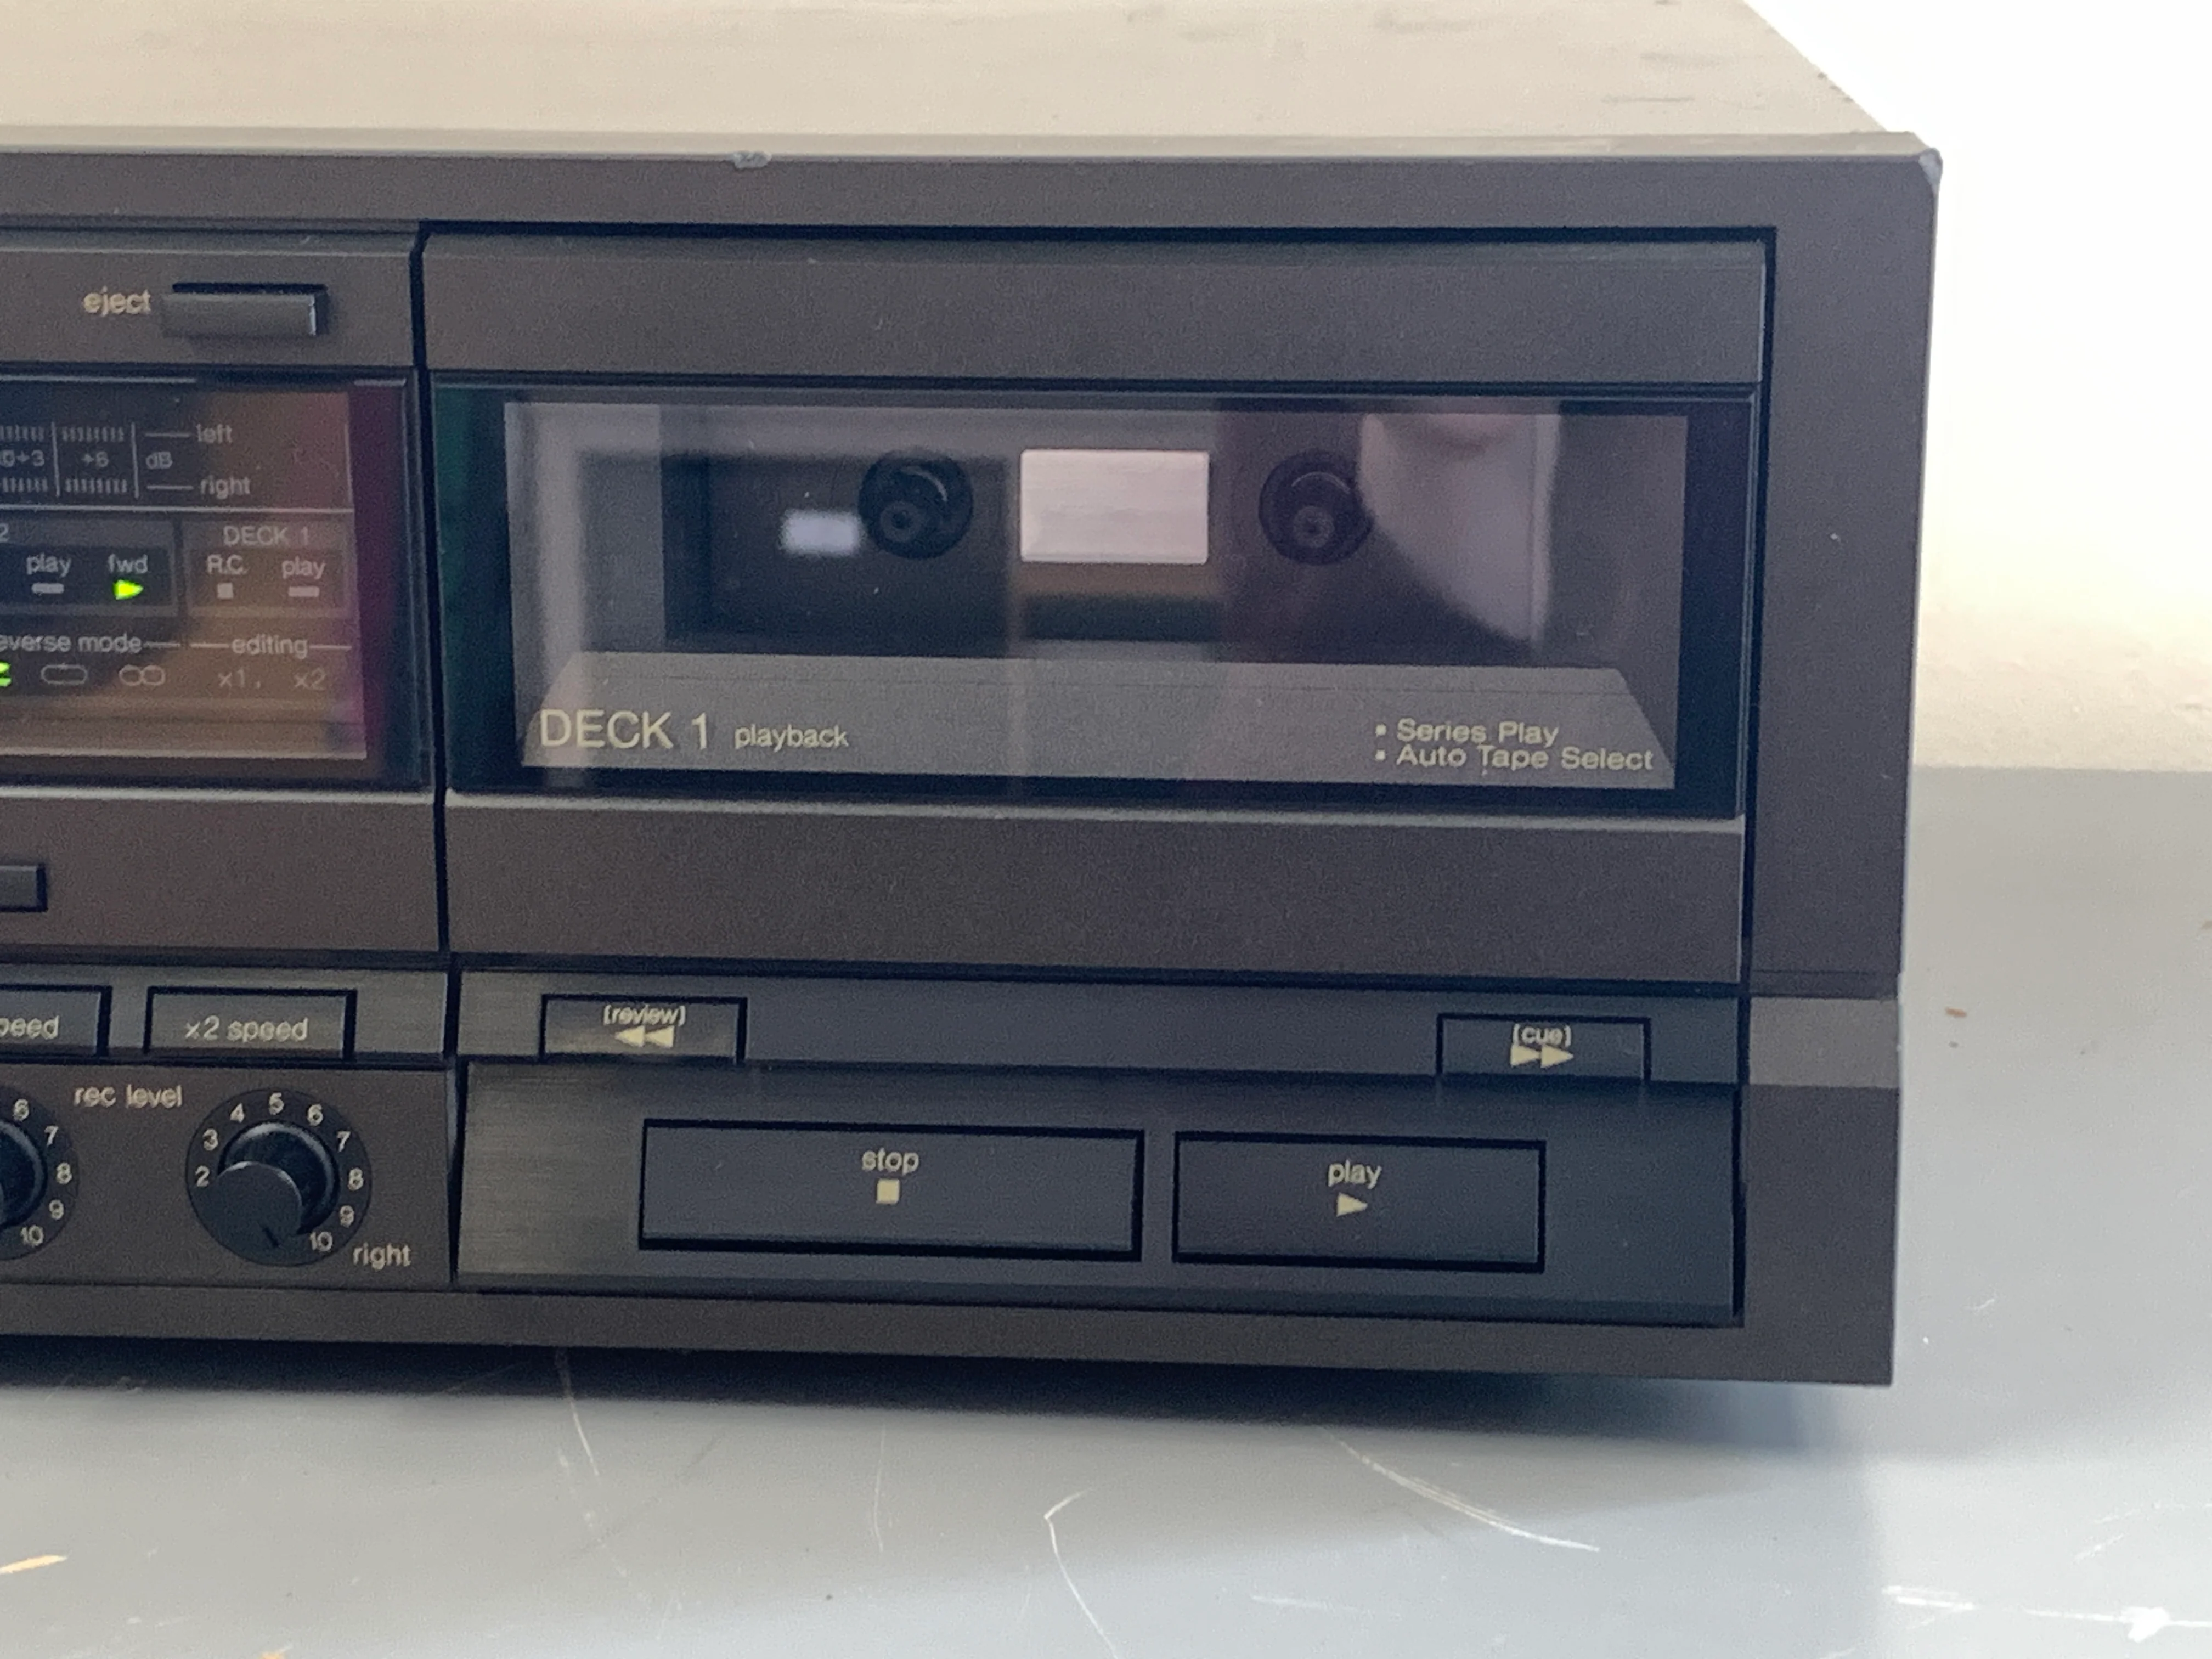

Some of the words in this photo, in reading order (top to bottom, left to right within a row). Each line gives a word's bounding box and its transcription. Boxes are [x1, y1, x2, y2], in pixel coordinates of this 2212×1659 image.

[83, 286, 150, 317] eject
[196, 424, 232, 443] left
[145, 450, 172, 469] dB
[200, 477, 250, 499] right
[223, 525, 288, 546] DECK
[301, 526, 309, 546] 1
[26, 554, 71, 578] play
[108, 554, 148, 574] fwd
[281, 556, 326, 580] play
[78, 634, 142, 653] mode
[231, 634, 308, 658] editing
[294, 667, 326, 691] x2
[540, 709, 674, 749] DECK
[691, 712, 707, 749] 1
[735, 724, 849, 753] playback
[1397, 718, 1486, 743] Series
[1498, 721, 1559, 748] Play
[1396, 744, 1467, 767] Auto
[1477, 744, 1549, 771] Tape
[1561, 746, 1654, 770] Select
[184, 1015, 220, 1041] x2
[226, 1017, 309, 1042] speed
[74, 1086, 117, 1104] rec
[125, 1085, 183, 1108] level
[268, 1092, 284, 1115] 5
[13, 1099, 29, 1121] 6
[230, 1104, 245, 1124] 4
[307, 1104, 324, 1126] 6
[44, 1126, 58, 1147] 7
[202, 1128, 218, 1151] 3
[336, 1131, 351, 1152] 7
[862, 1147, 919, 1176] stop
[56, 1162, 72, 1185] 8
[195, 1165, 210, 1188] 2
[347, 1167, 364, 1190] 8
[1327, 1158, 1382, 1189] play
[48, 1199, 64, 1220] 9
[339, 1205, 354, 1228] 9
[20, 1226, 44, 1247] 10
[309, 1231, 334, 1252] 10
[353, 1242, 411, 1271] right
